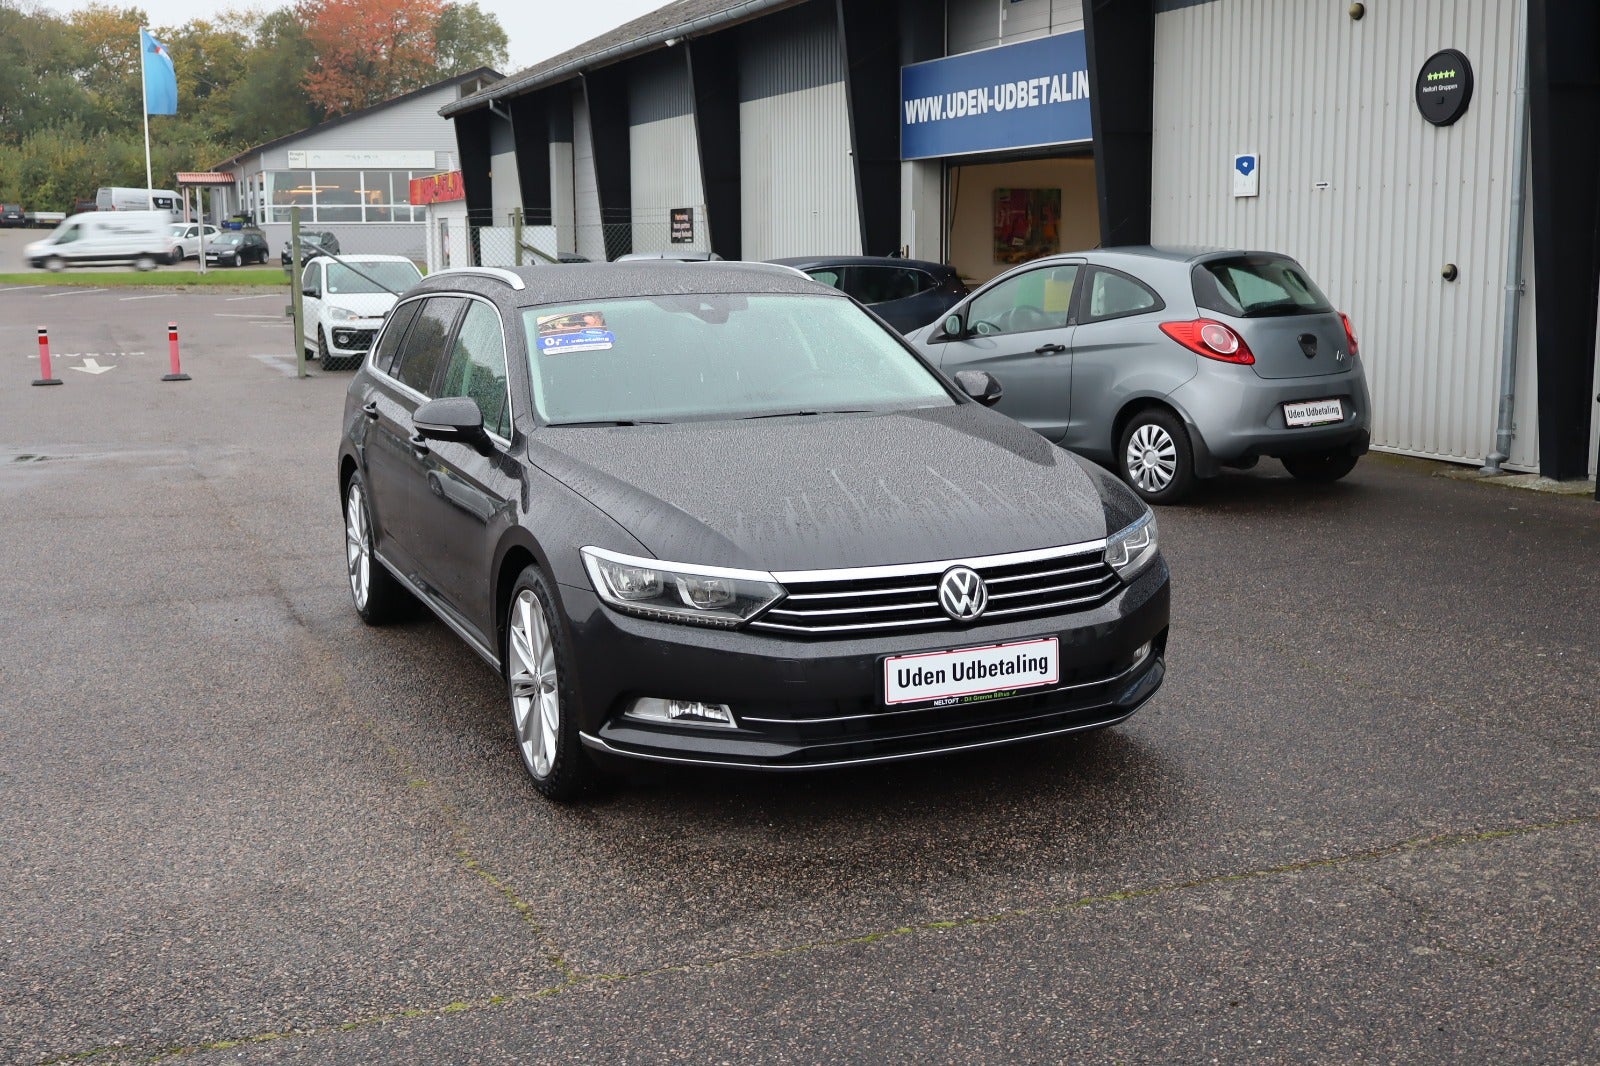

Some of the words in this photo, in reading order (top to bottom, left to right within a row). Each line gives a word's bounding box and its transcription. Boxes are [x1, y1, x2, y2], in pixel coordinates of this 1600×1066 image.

[1287, 409, 1305, 419] Uden
[1305, 405, 1340, 417] Udbetaling
[897, 666, 946, 688] Uden
[952, 653, 1048, 682] Udbetaling
[933, 697, 960, 706] NELTOFT
